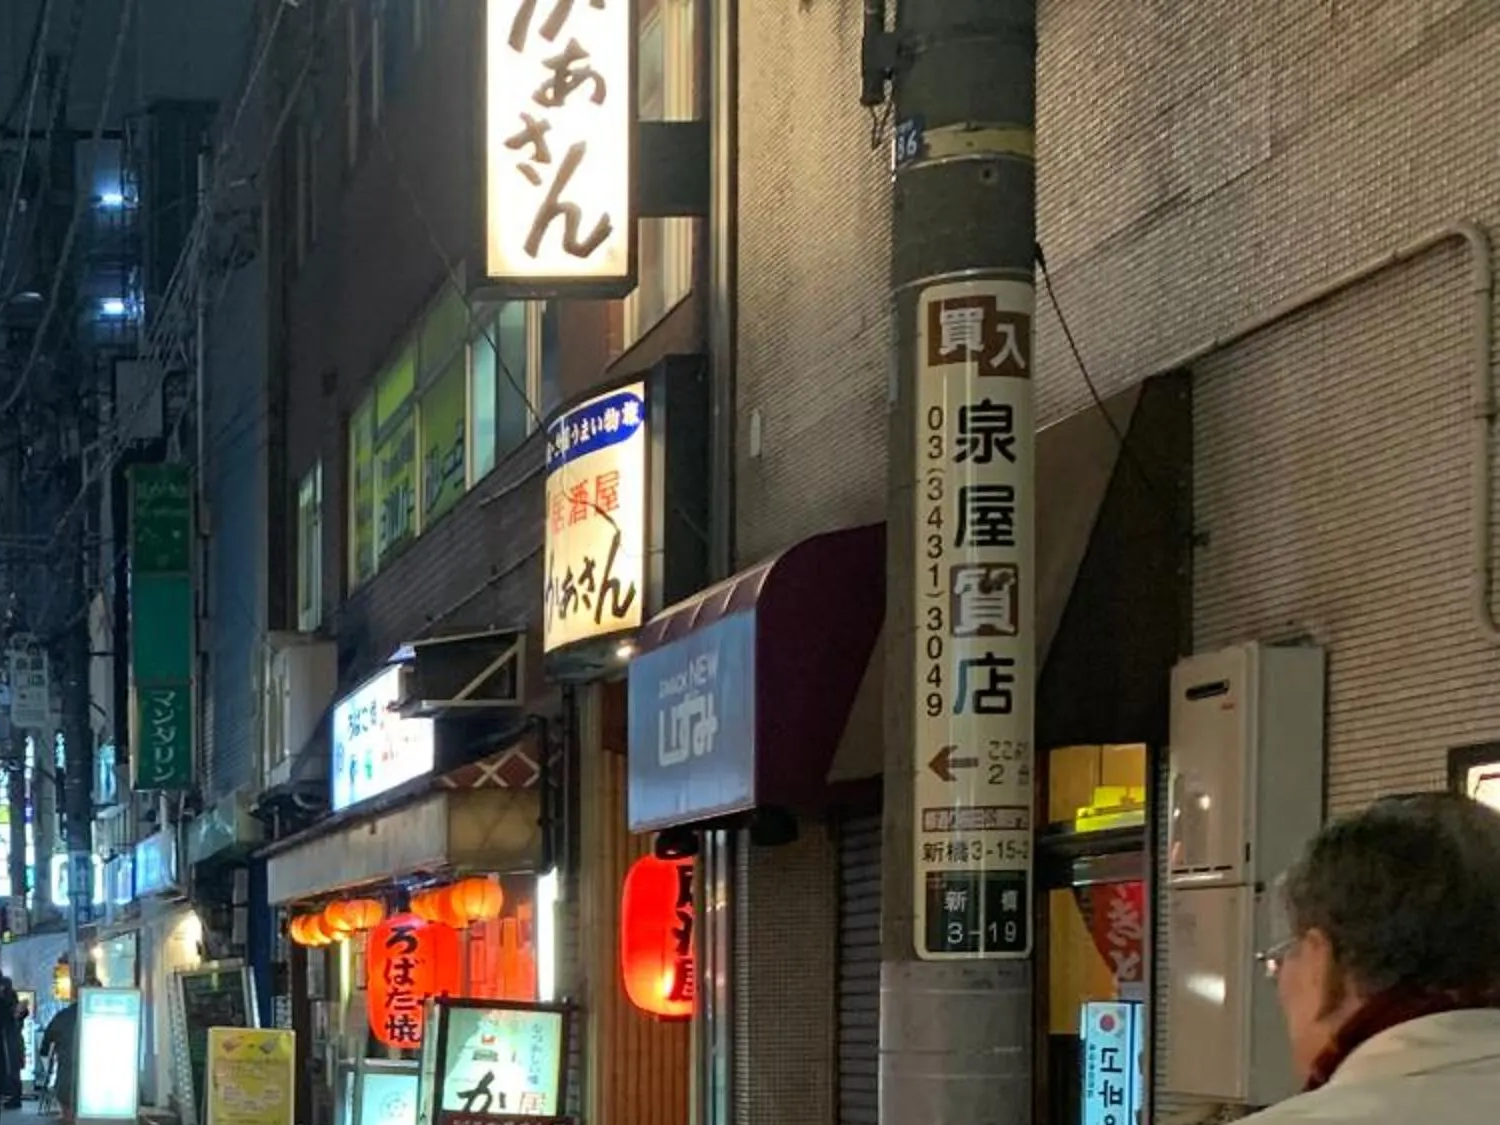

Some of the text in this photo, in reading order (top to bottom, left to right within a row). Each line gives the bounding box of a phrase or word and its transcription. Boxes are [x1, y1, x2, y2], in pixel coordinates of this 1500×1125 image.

[949, 399, 1020, 716] 泉屋質店
[689, 653, 719, 688] NEW
[151, 687, 177, 783] マンダリン
[947, 922, 1017, 945] 3-19
[384, 925, 421, 1043] ろばた焼
